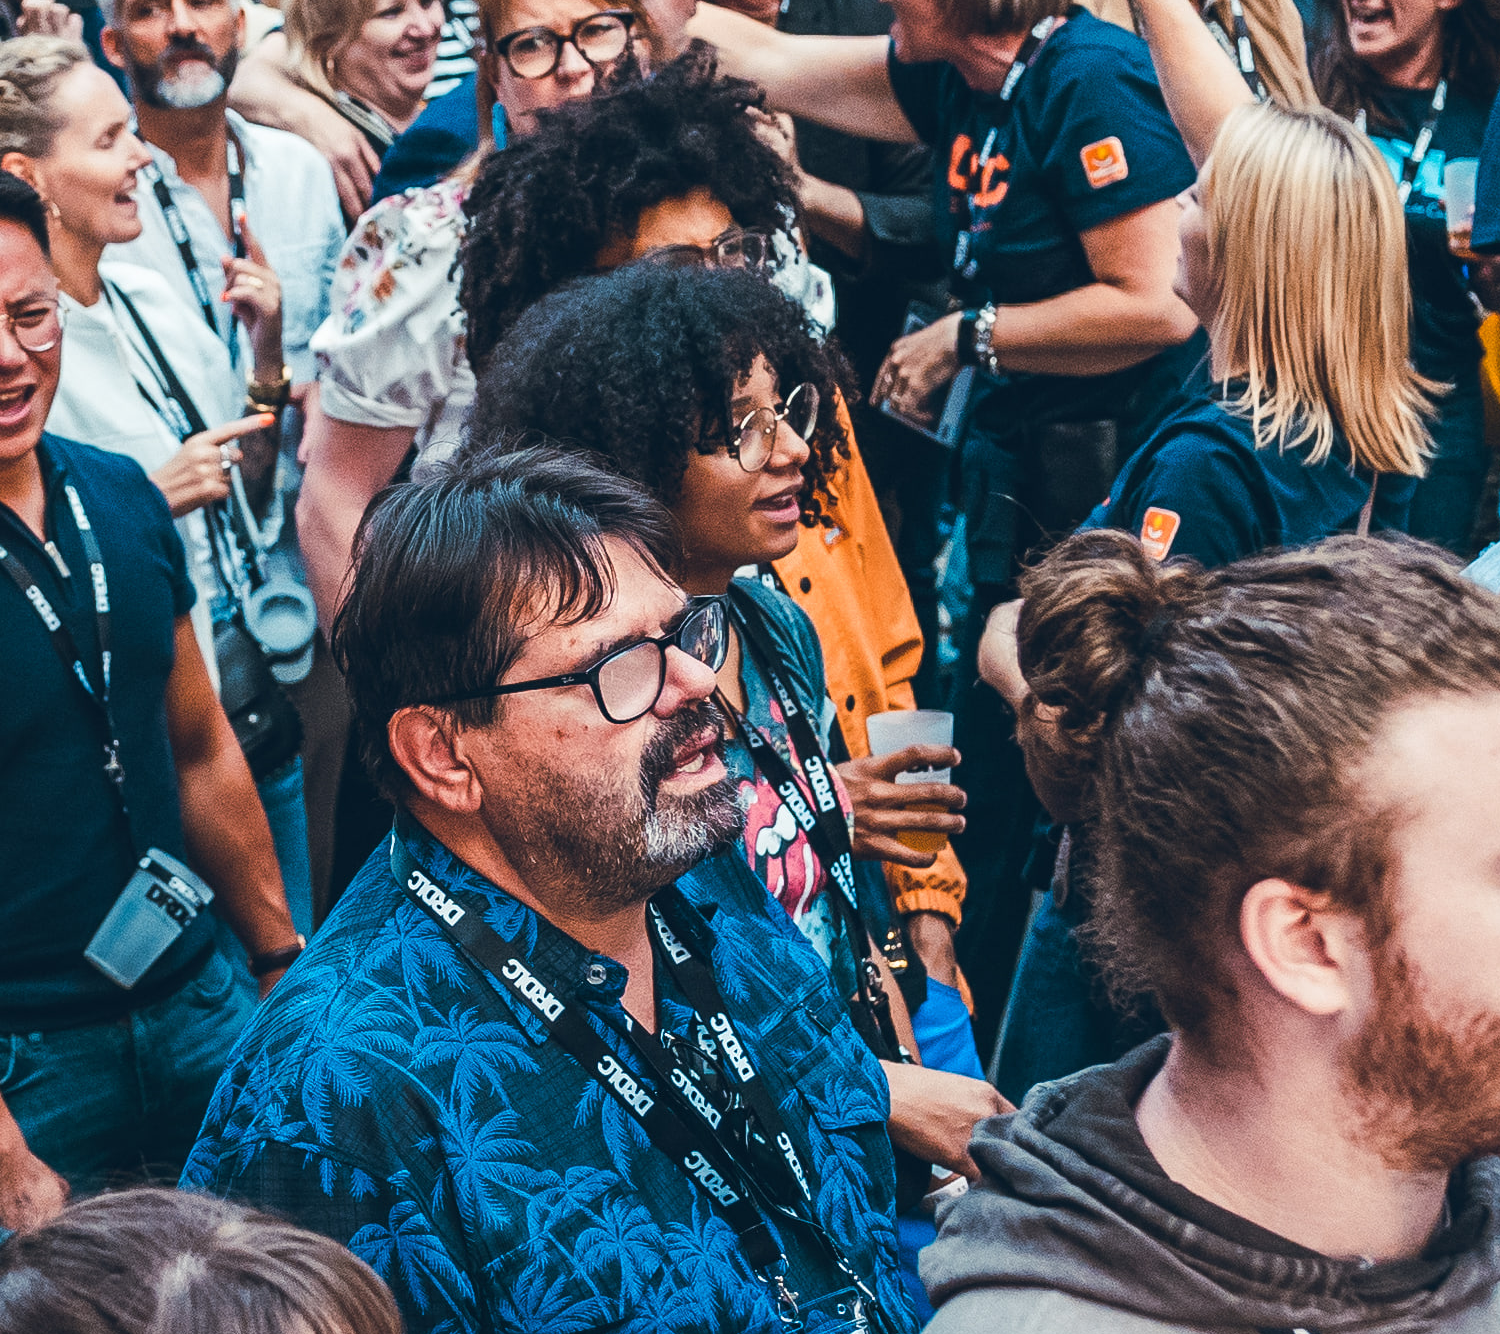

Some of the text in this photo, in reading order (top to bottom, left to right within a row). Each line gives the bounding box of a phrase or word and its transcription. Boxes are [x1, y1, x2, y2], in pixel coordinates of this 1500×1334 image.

[779, 779, 817, 833] DRDLC
[805, 755, 836, 813] DRDLC
[407, 870, 466, 927] DRDLC
[649, 902, 692, 966] DRDLC
[502, 958, 566, 1023] DRDLC
[709, 1011, 756, 1083] DRDLC
[597, 1054, 655, 1118] DRDLC
[671, 1067, 722, 1130] DRDLC
[684, 1150, 740, 1208] DRDLC
